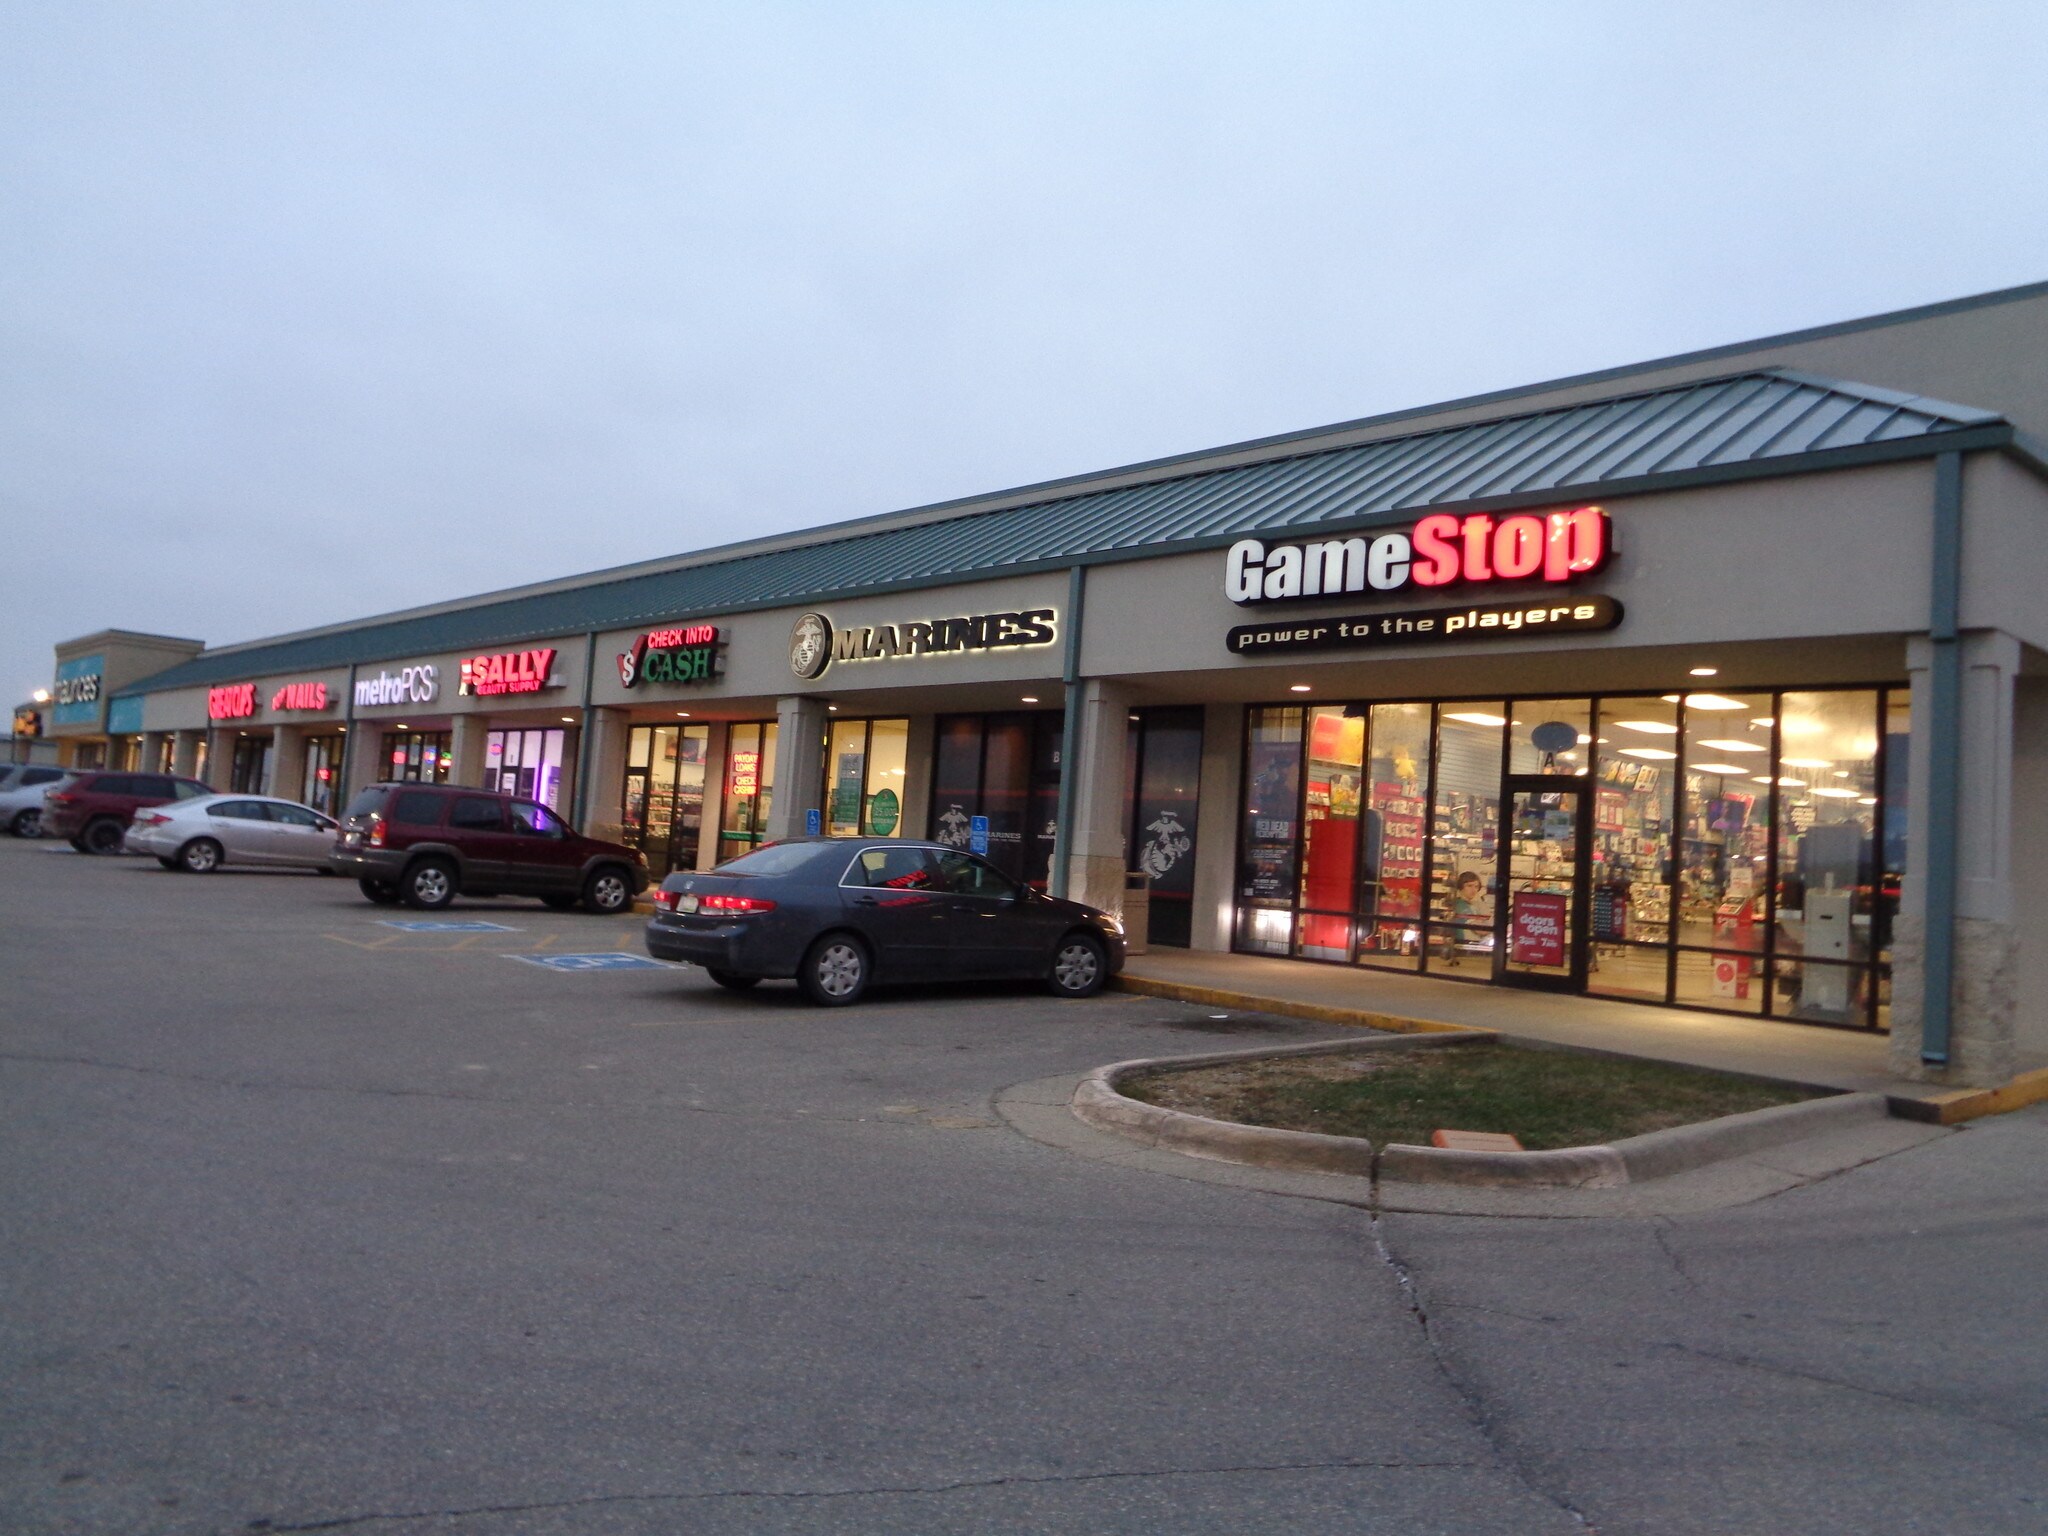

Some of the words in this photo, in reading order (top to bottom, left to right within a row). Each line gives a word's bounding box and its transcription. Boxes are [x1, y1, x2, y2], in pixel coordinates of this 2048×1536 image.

[1225, 506, 1604, 602] GameStop
[647, 629, 683, 649] CHECK
[685, 625, 713, 645] INTO
[832, 609, 1056, 661] MARINES
[1239, 627, 1328, 649] power
[1338, 623, 1370, 638] to
[1380, 618, 1435, 635] the
[1445, 604, 1596, 634] players
[472, 648, 553, 686] SALLY
[286, 682, 326, 710] NAILS
[354, 664, 435, 706] metroPCS
[476, 684, 508, 696] BEAUTY
[509, 679, 541, 694] SUPPLY
[1544, 752, 1555, 767] A
[1527, 924, 1558, 936] open
